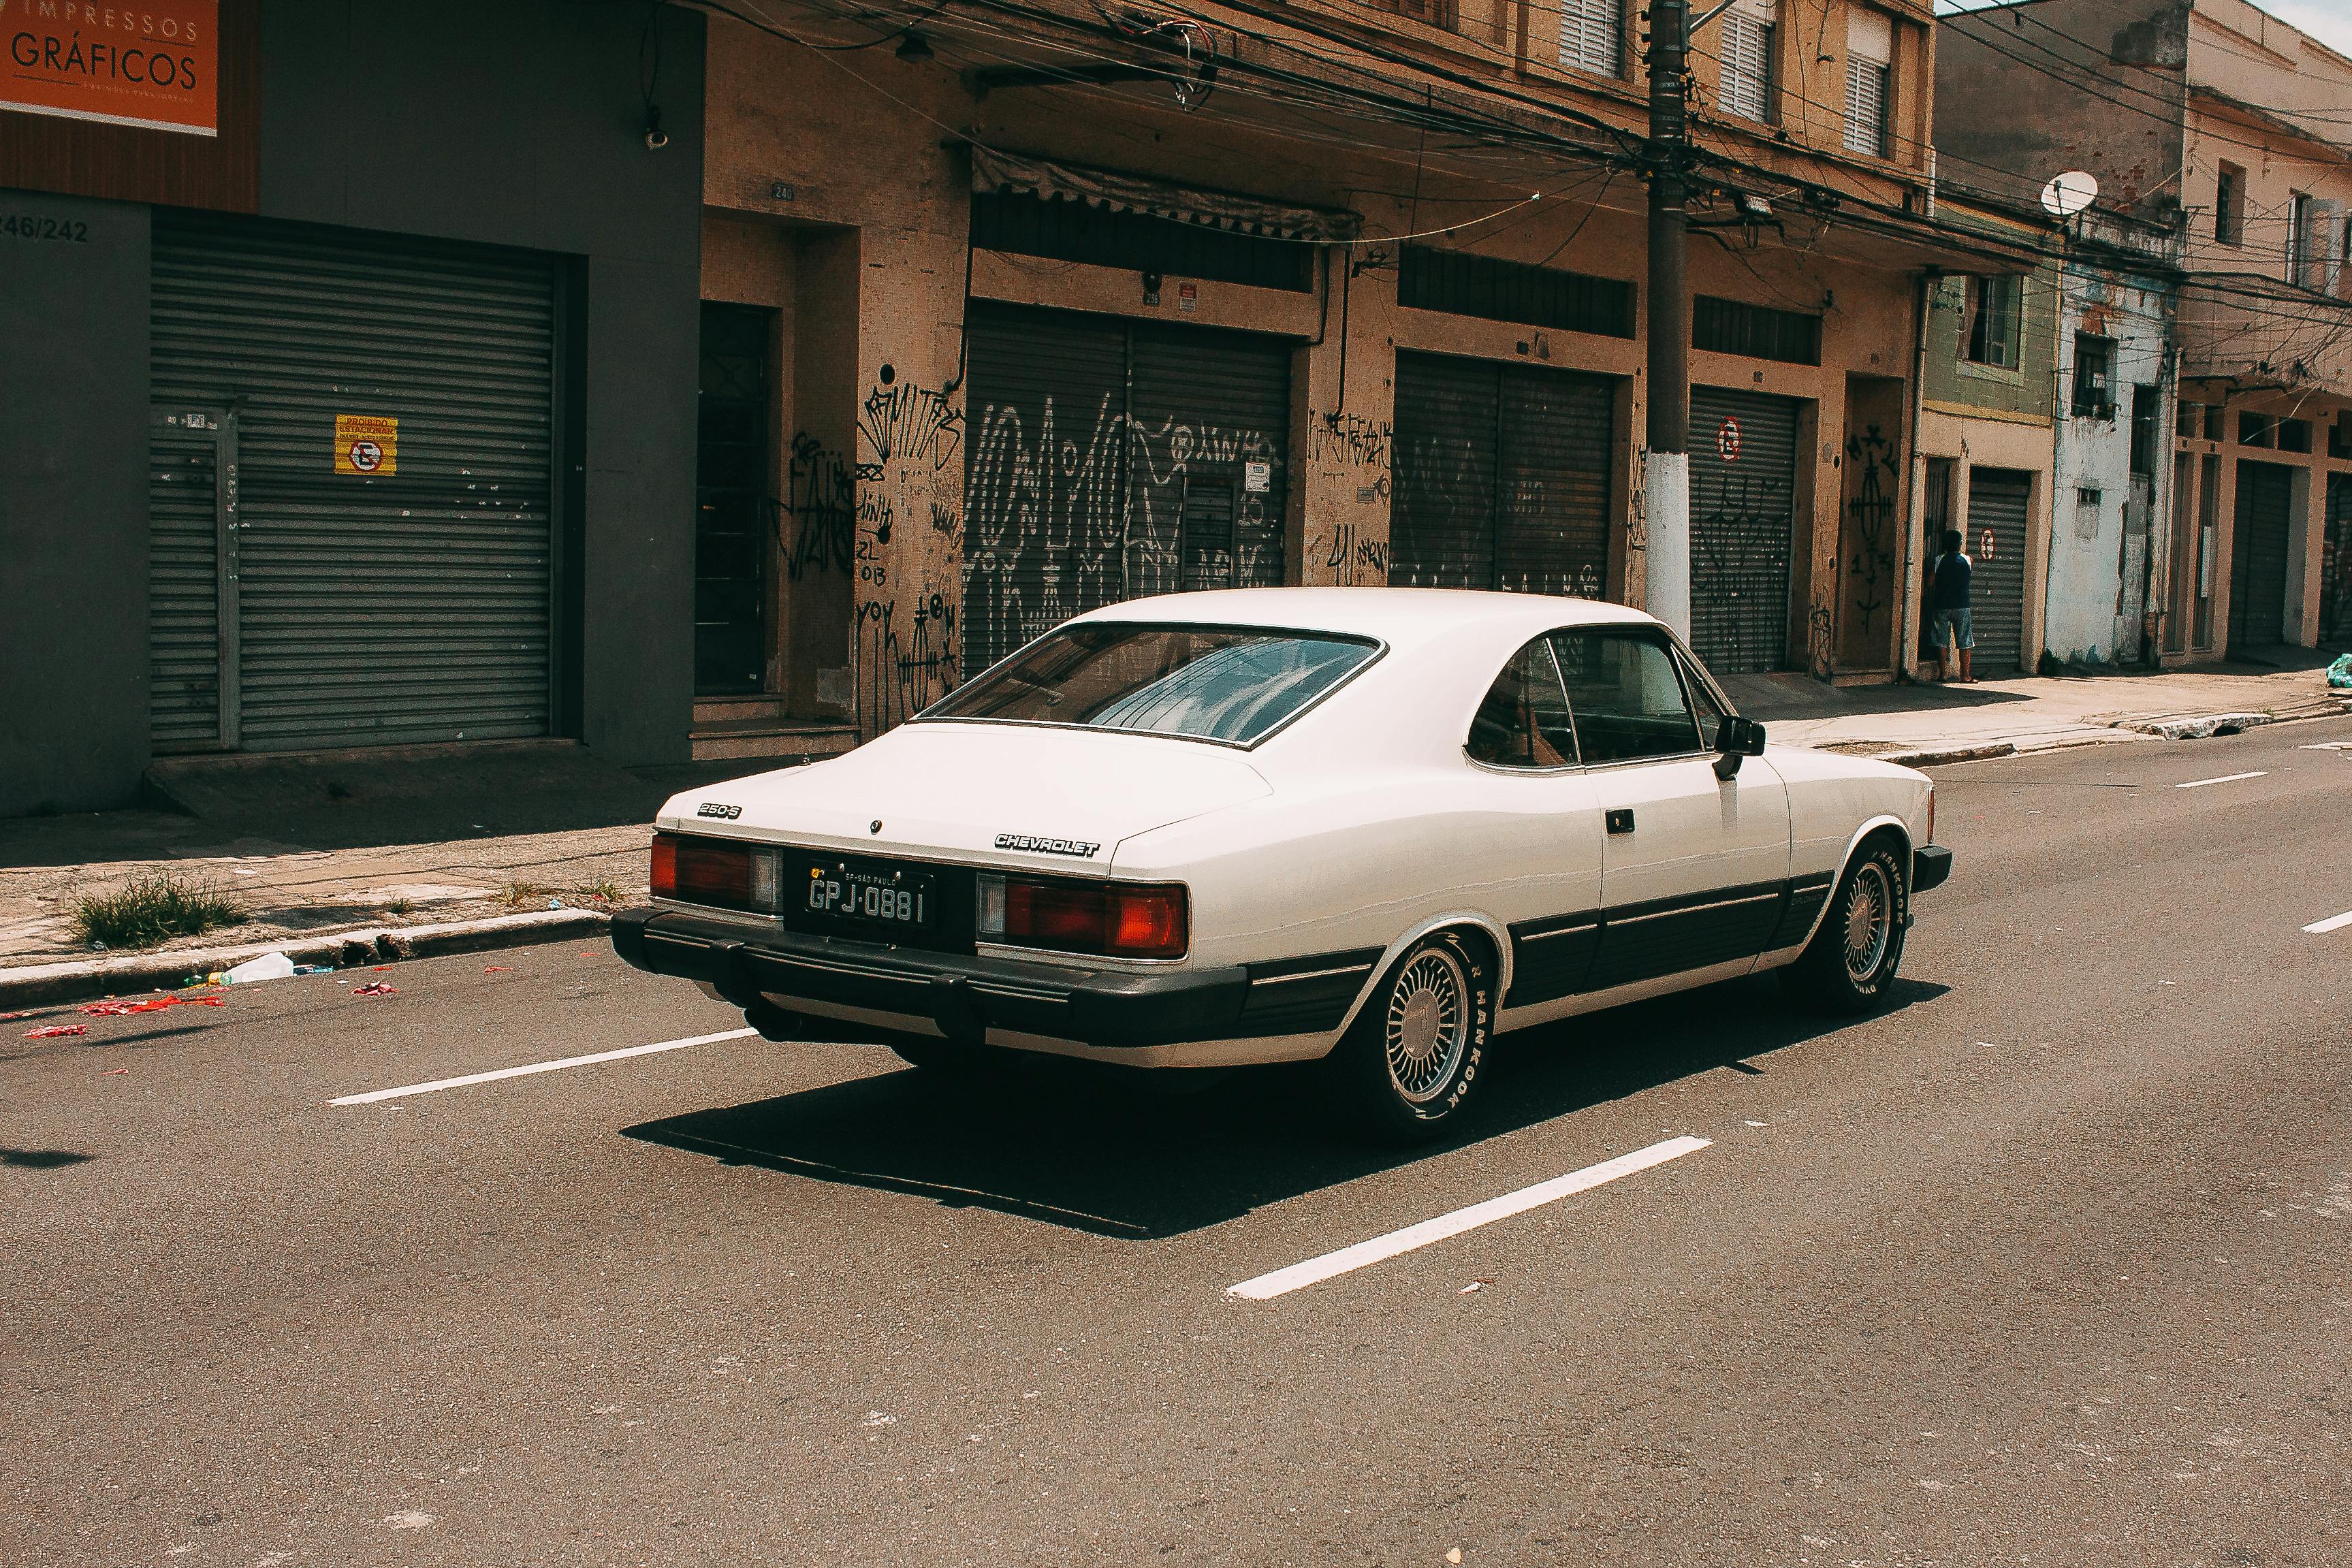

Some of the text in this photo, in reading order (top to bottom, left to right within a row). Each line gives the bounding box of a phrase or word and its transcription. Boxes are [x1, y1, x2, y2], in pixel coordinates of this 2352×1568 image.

[22, 0, 196, 41] IMPRESSOS
[12, 30, 196, 90] GRÁFICOS
[776, 187, 792, 199] 240
[0, 214, 87, 242] 46/242
[347, 417, 388, 427] PROIBIDO
[994, 833, 1100, 859] CHEVROLET
[874, 876, 896, 886] PAULO
[1446, 990, 1487, 1108] HANKOOK
